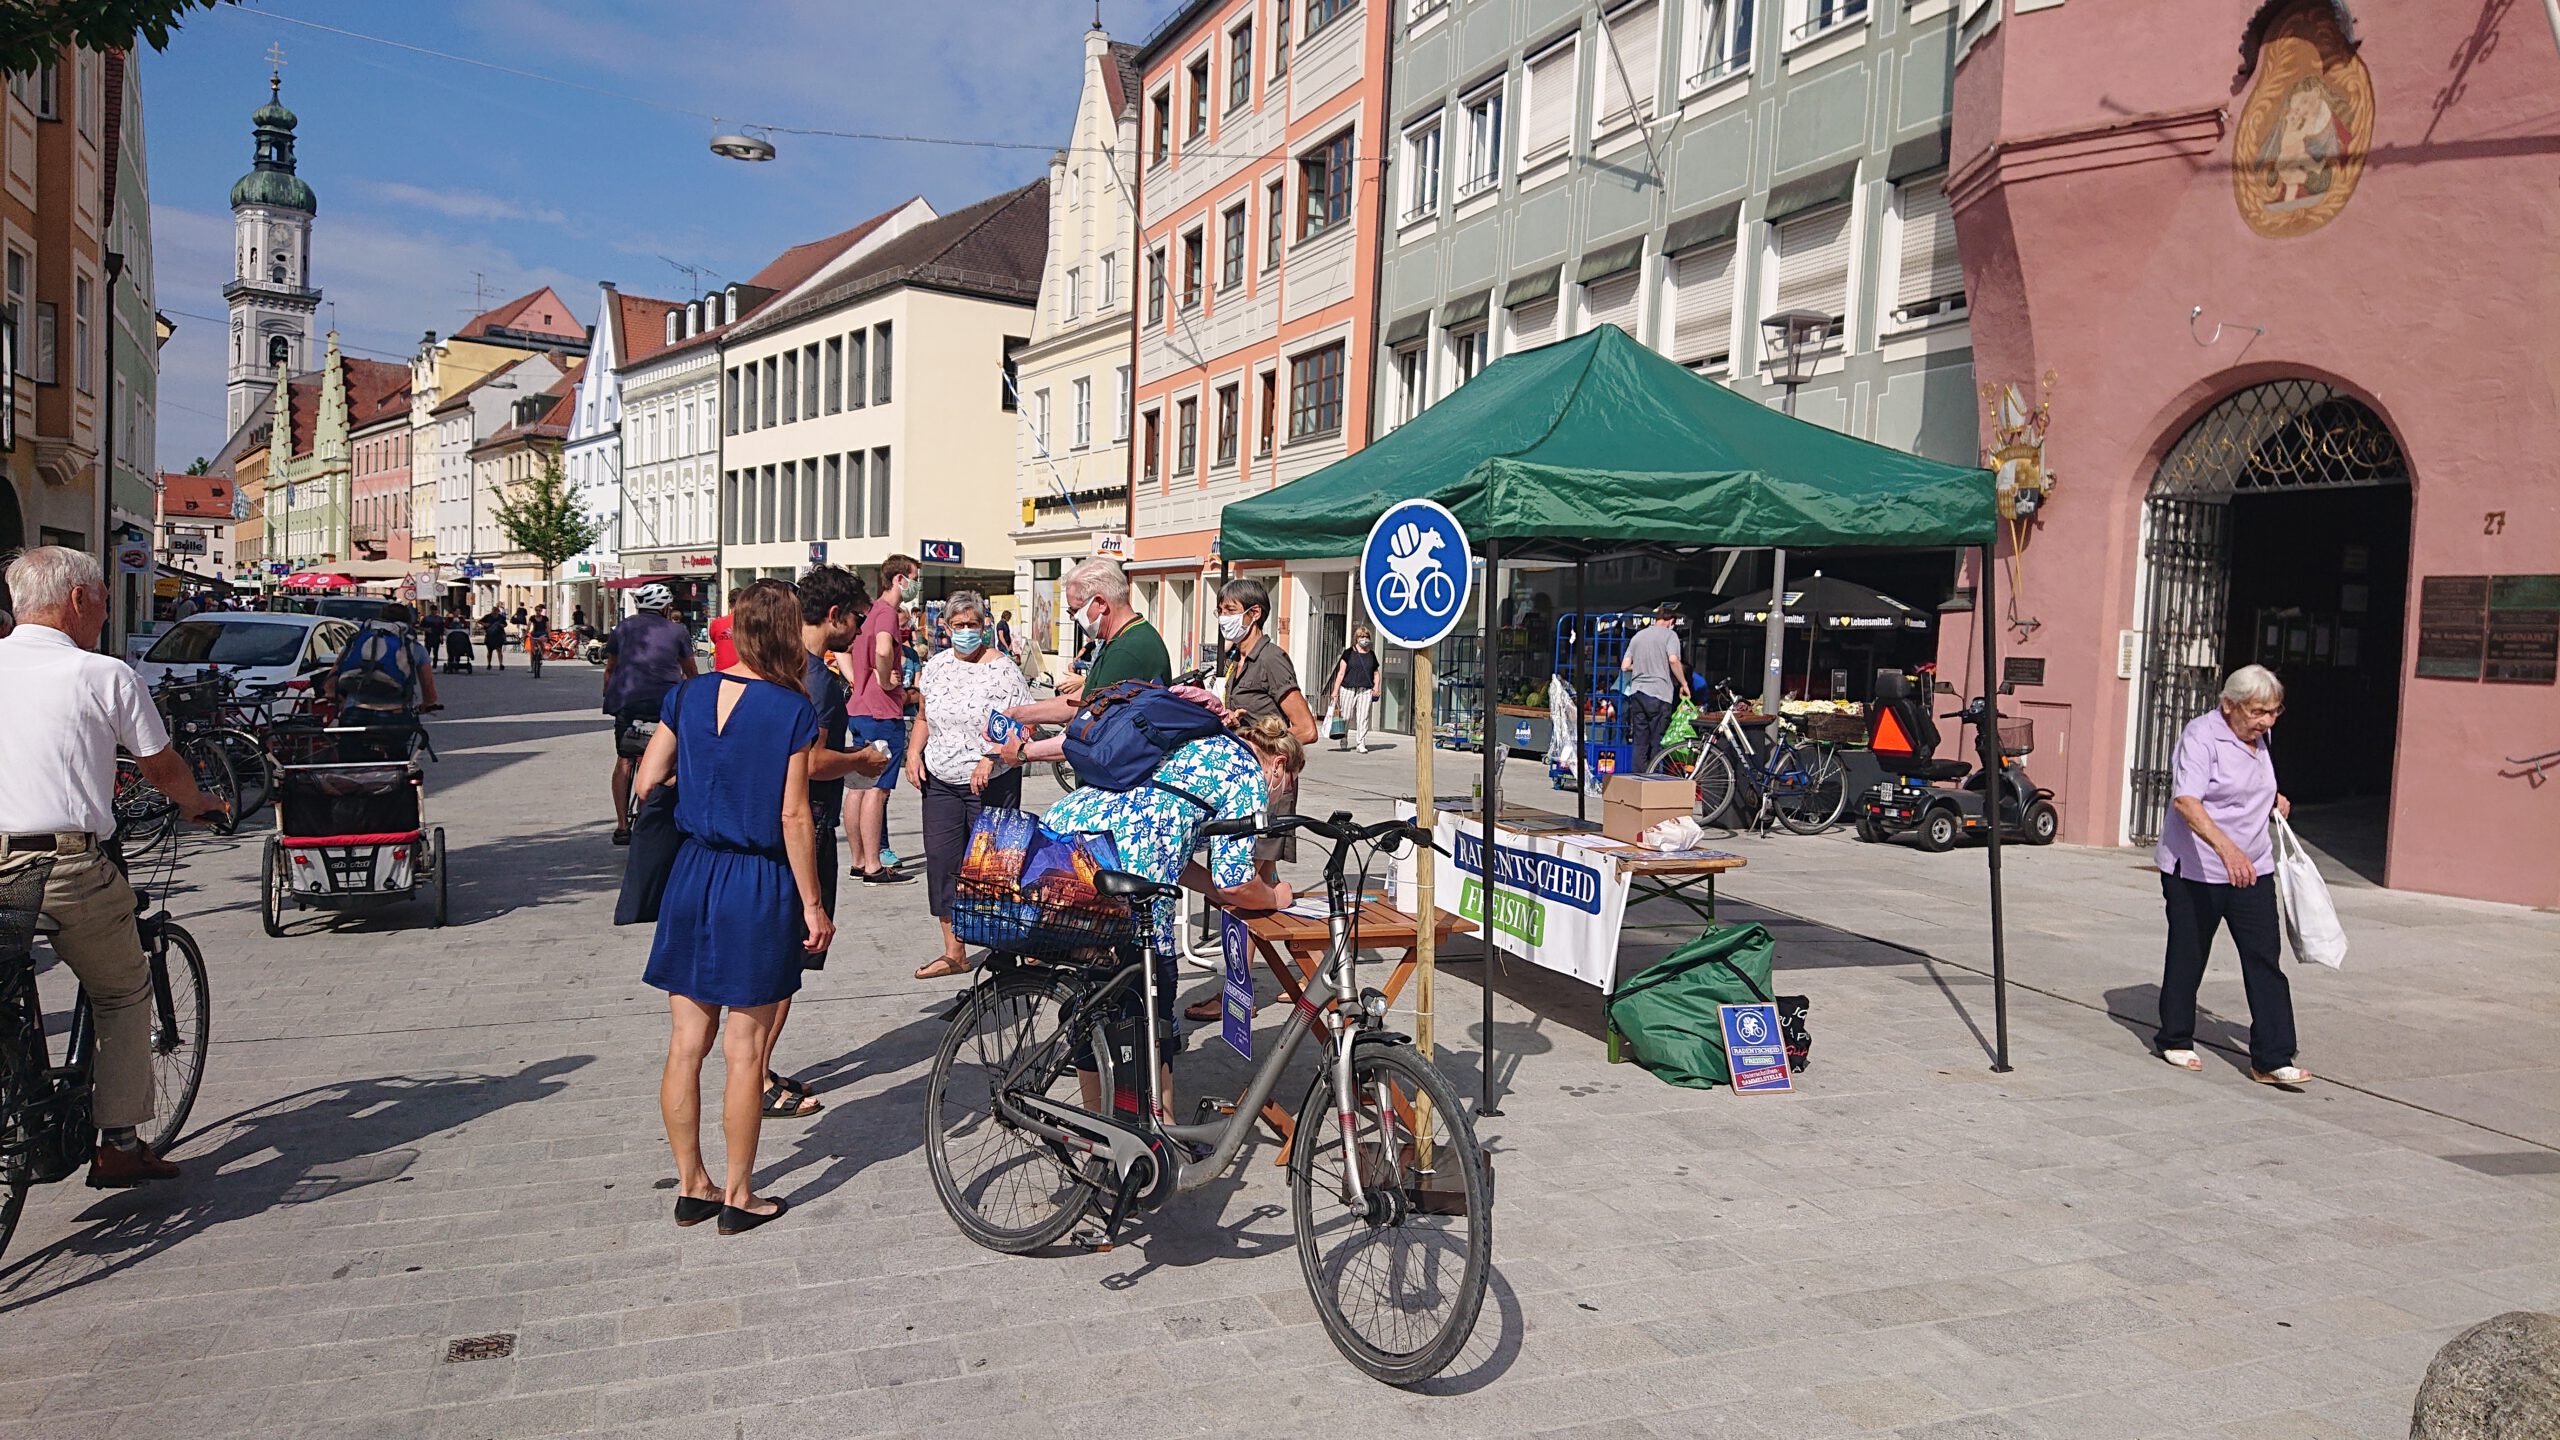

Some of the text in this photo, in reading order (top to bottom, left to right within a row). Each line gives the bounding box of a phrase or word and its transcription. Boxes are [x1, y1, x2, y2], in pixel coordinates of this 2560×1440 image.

[2484, 511, 2506, 535] 27
[1101, 537, 1121, 550] dm
[810, 545, 822, 559] K&L
[925, 543, 960, 558] K&L
[1745, 612, 1756, 622] Wir
[1829, 617, 1840, 626] Wir
